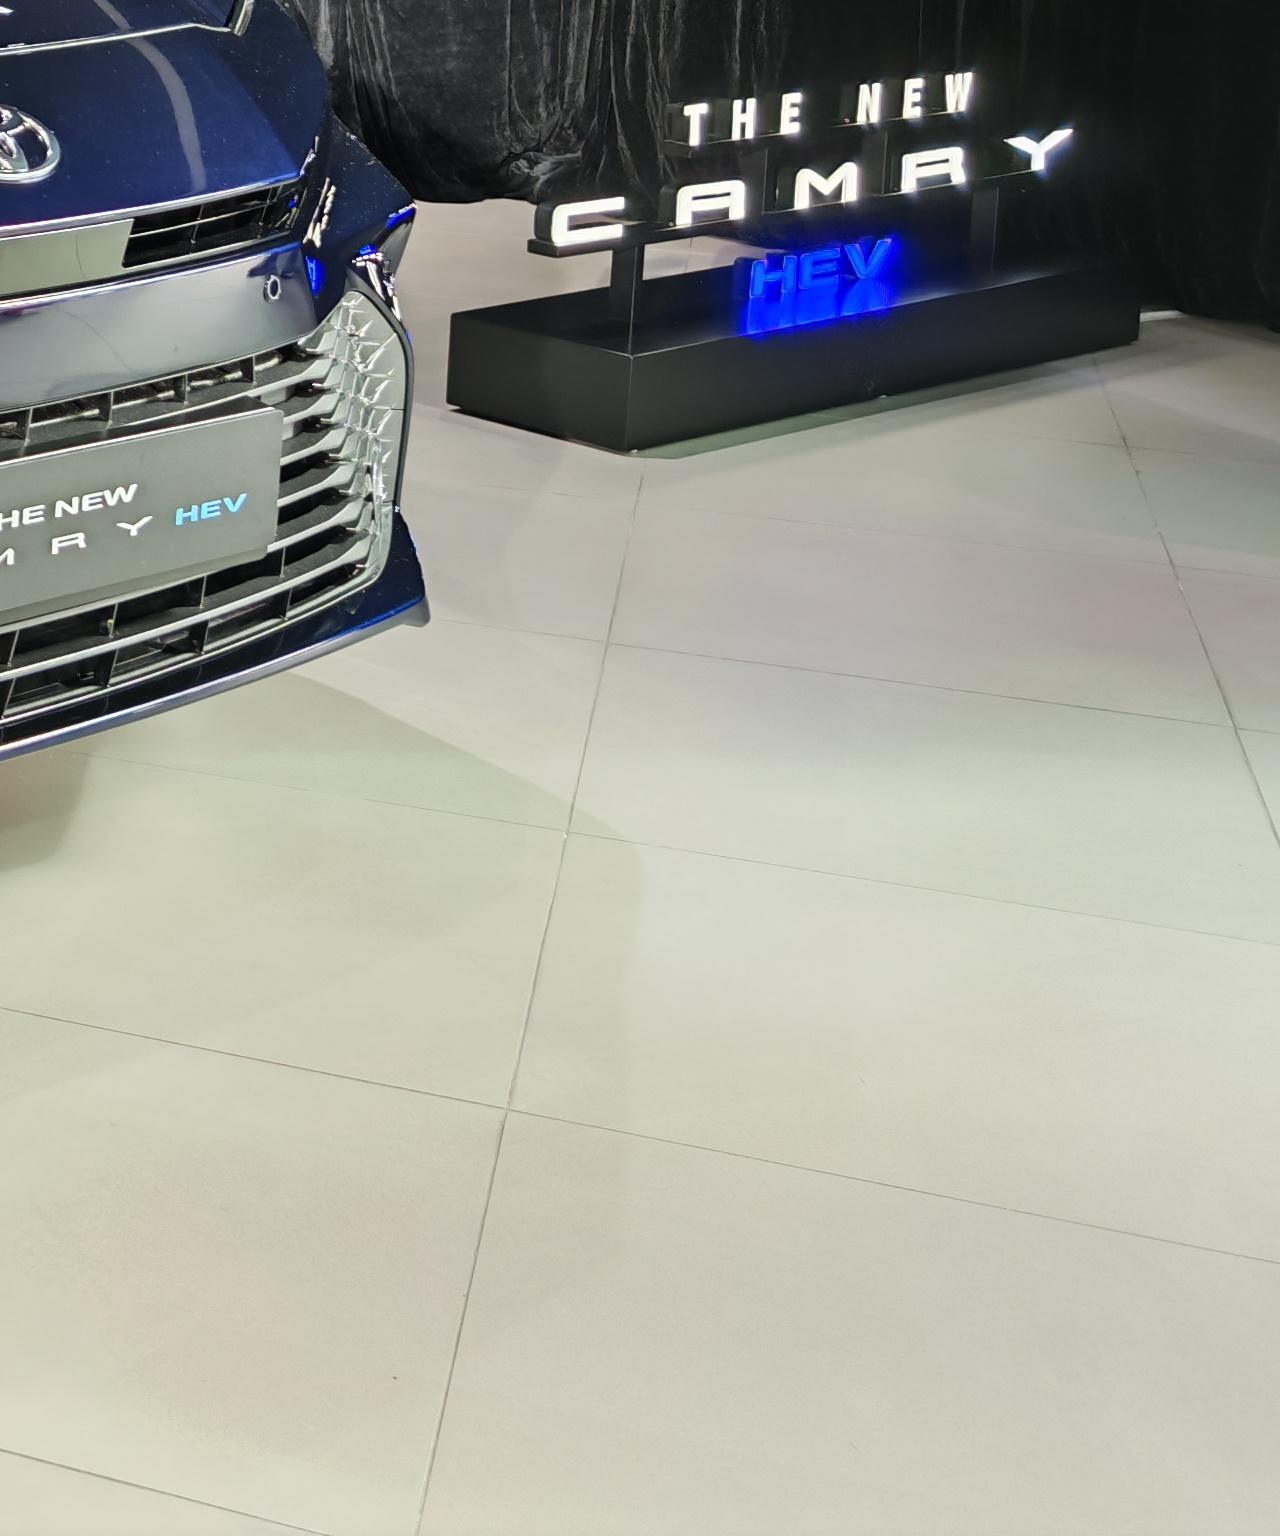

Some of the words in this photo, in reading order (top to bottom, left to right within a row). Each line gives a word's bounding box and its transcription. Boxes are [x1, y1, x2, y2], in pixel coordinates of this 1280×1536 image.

[683, 92, 804, 147] THE
[856, 71, 974, 125] NEW
[550, 128, 1074, 248] CAMRY
[748, 237, 892, 298] HEV
[54, 483, 139, 518] NEW
[175, 493, 247, 526] HEV
